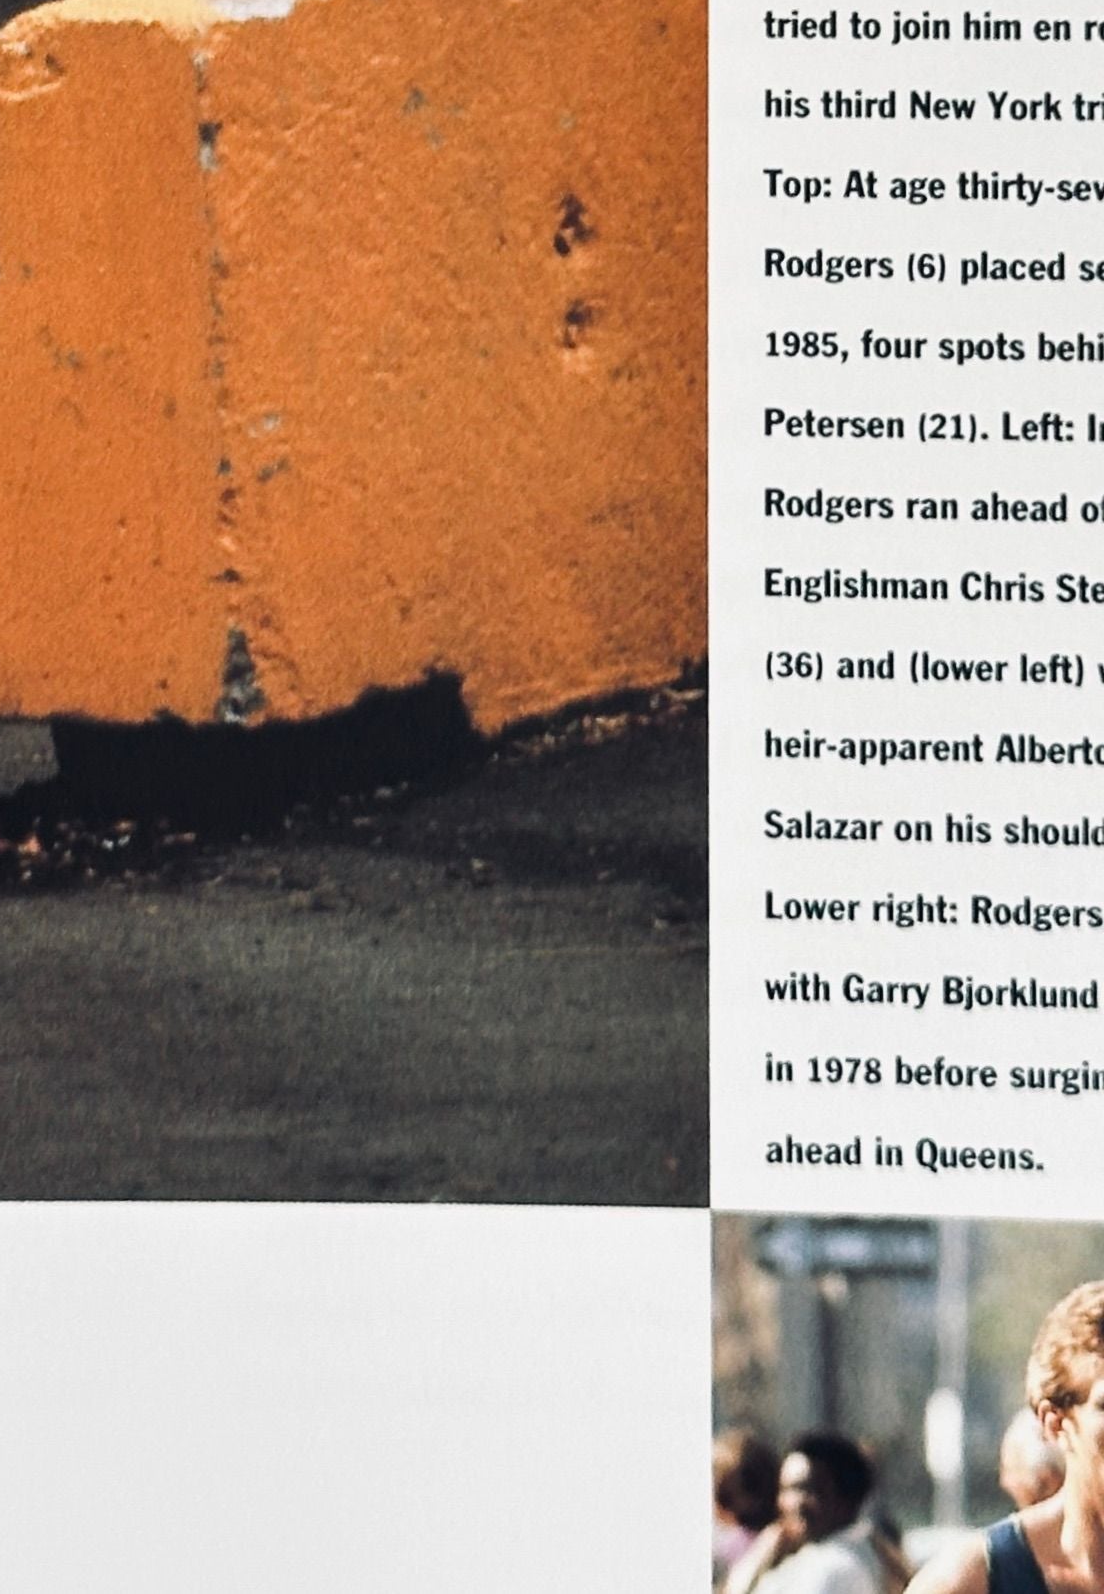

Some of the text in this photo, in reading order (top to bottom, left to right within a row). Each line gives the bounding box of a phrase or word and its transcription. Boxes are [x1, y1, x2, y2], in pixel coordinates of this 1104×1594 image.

[763, 10, 837, 39] tried
[849, 11, 882, 40] to
[891, 10, 951, 45] join
[963, 11, 1022, 41] him
[1033, 19, 1071, 42] en
[765, 89, 811, 119] his
[820, 89, 896, 119] third
[910, 90, 976, 120] New
[987, 91, 1062, 121] York
[762, 168, 832, 204] Top:
[843, 169, 878, 199] At
[889, 177, 946, 206] age
[764, 248, 894, 284] Rodgers
[907, 253, 946, 283] (6)
[960, 250, 1066, 286] placed
[766, 328, 1104, 366] 1985, four spots behi
[764, 408, 905, 439] Petersen
[918, 413, 989, 444] (21).
[1002, 411, 1074, 442] Left:
[764, 488, 894, 524] Rodgers
[906, 498, 958, 520] ran
[971, 491, 1068, 523] ahead
[764, 568, 949, 604] Englishman
[960, 571, 1045, 603] Chris
[766, 651, 823, 681] (36)
[836, 651, 895, 680] and
[910, 651, 1009, 684] (lower
[1020, 653, 1084, 688] left)
[764, 728, 984, 766] heir-apparent
[764, 809, 883, 841] Salazar
[894, 820, 933, 842] on
[946, 813, 992, 844] his
[765, 890, 1104, 932] Lower right: Rodgers
[765, 972, 1099, 1011] with Garry Bjorklund
[765, 1052, 793, 1082] in
[809, 1057, 882, 1085] 1978
[895, 1055, 998, 1088] before
[765, 1135, 1044, 1174] ahead in Queens.
